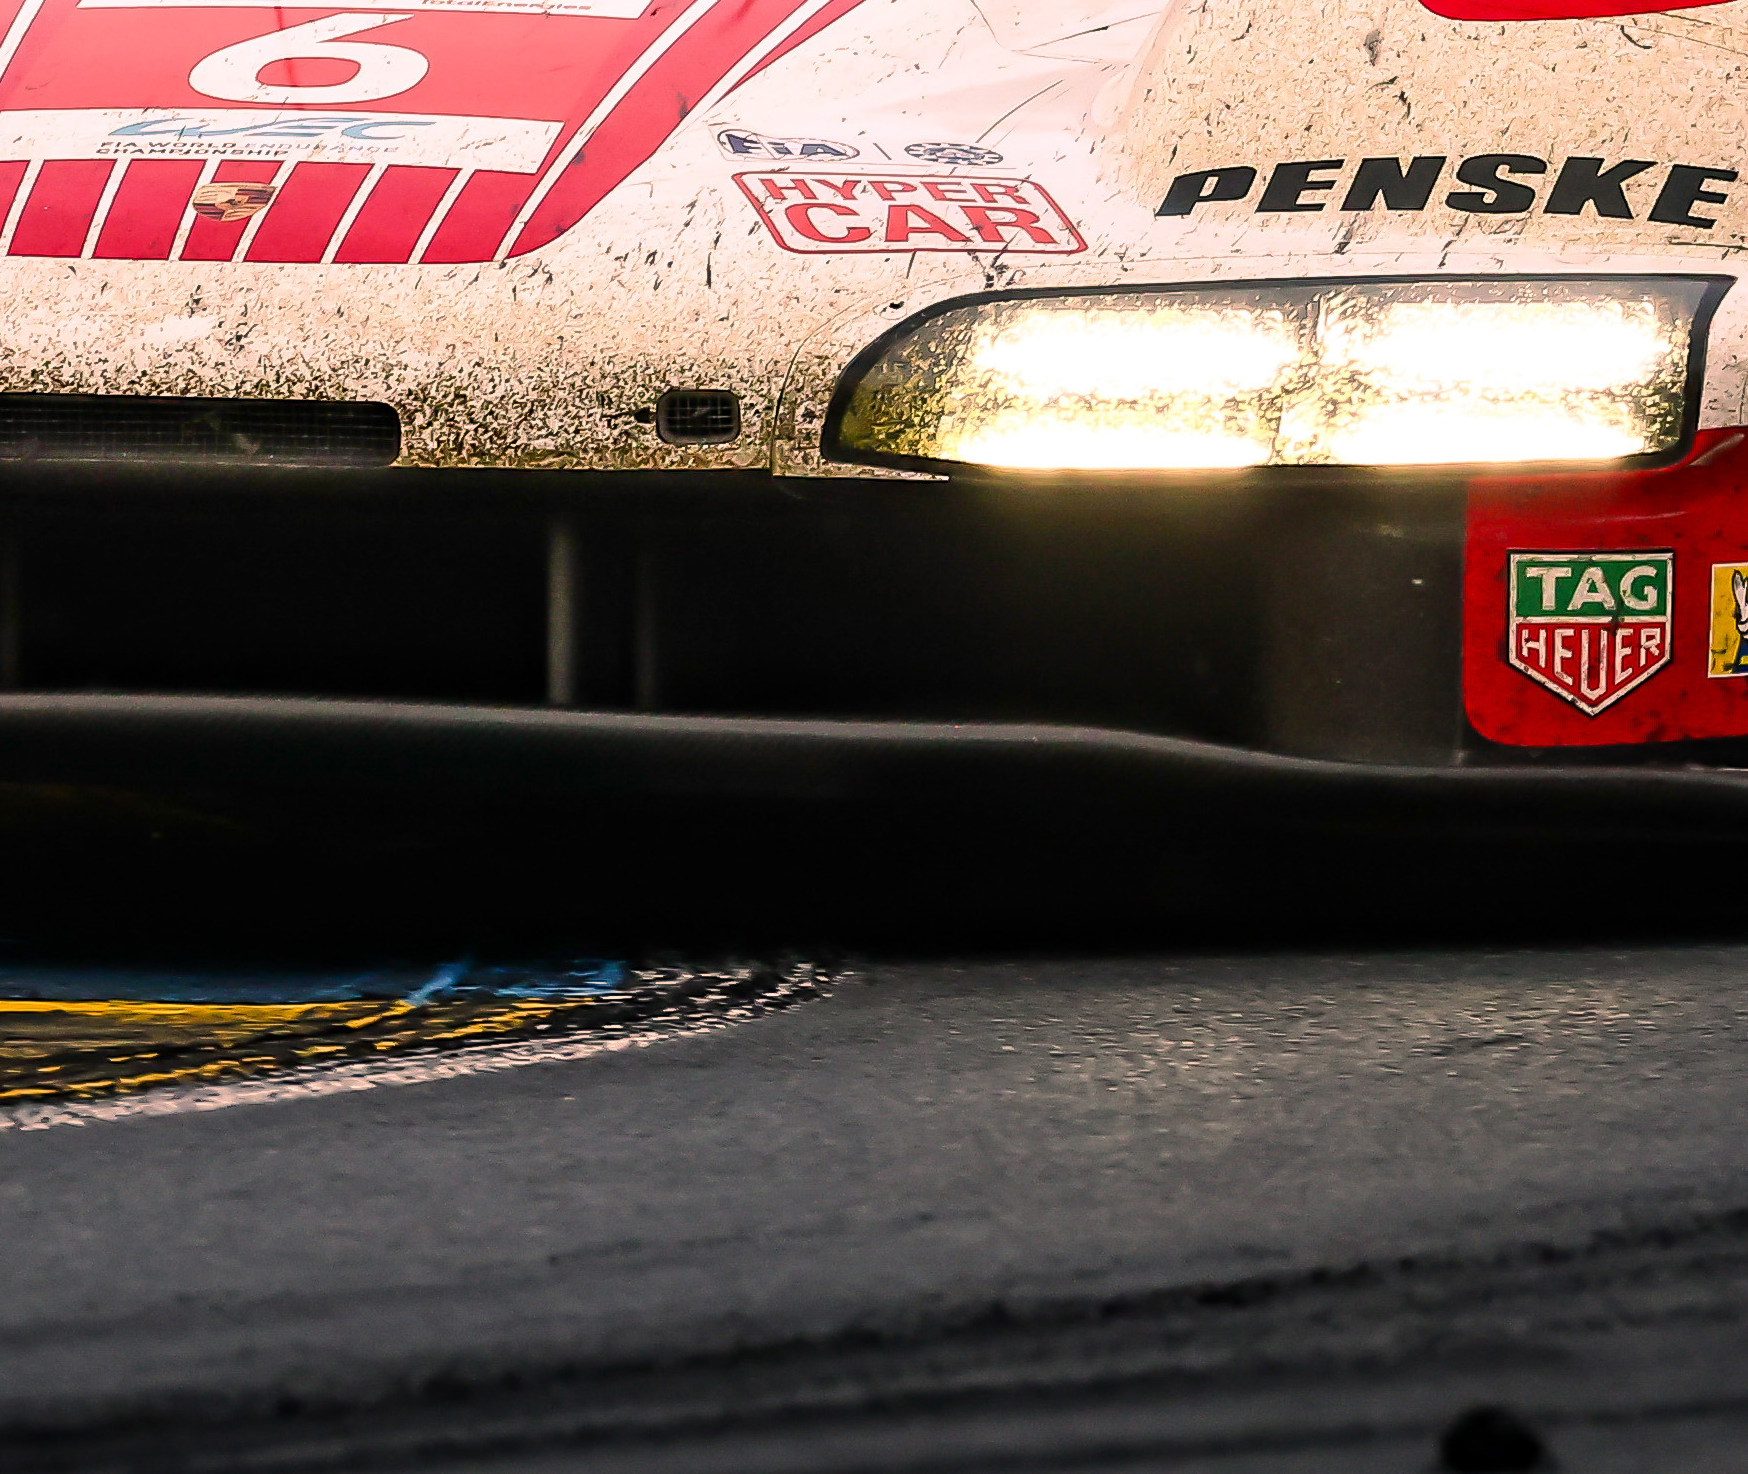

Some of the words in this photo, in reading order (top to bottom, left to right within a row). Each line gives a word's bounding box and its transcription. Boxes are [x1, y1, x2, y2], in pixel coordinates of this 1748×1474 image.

[188, 12, 431, 105] 6
[108, 117, 437, 140] WEC
[725, 133, 847, 157] FIA
[95, 147, 291, 157] CHAMPIONSHIP
[100, 141, 138, 149] FIA
[147, 141, 238, 149] WORLD
[244, 142, 401, 154] ENDURANCE
[758, 178, 1032, 205] HYPER
[1153, 152, 1739, 230] PENSKE
[783, 202, 1061, 245] CAR
[1525, 565, 1659, 612] TAG
[1520, 627, 1662, 701] HEUER
